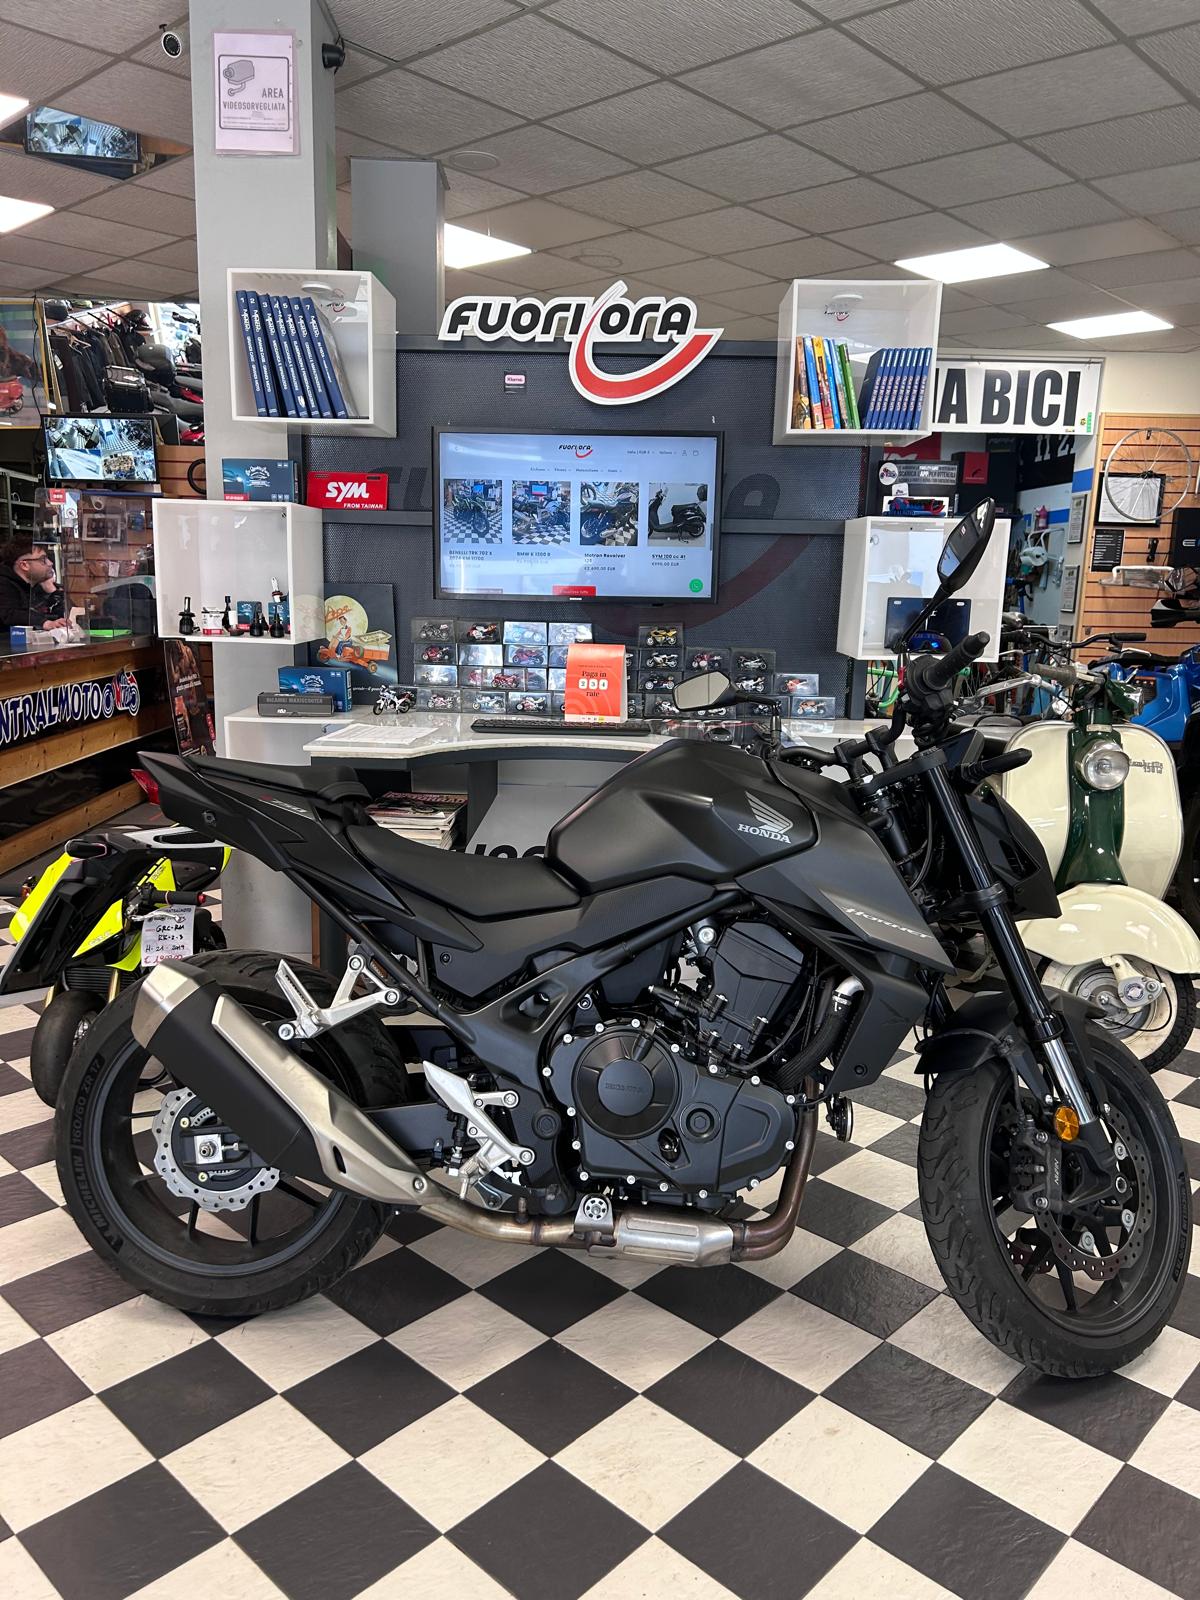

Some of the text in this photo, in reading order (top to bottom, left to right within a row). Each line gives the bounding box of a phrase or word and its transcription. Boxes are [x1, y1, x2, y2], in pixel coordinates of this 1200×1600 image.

[262, 88, 284, 98] AREA
[222, 102, 286, 111] VIDEOSORVEGLIATA
[981, 370, 1081, 427] BICI
[326, 482, 370, 502] SYM
[738, 824, 791, 844] HONDA
[72, 1096, 86, 1145] 160/60
[72, 1155, 110, 1228] MICHELIN
